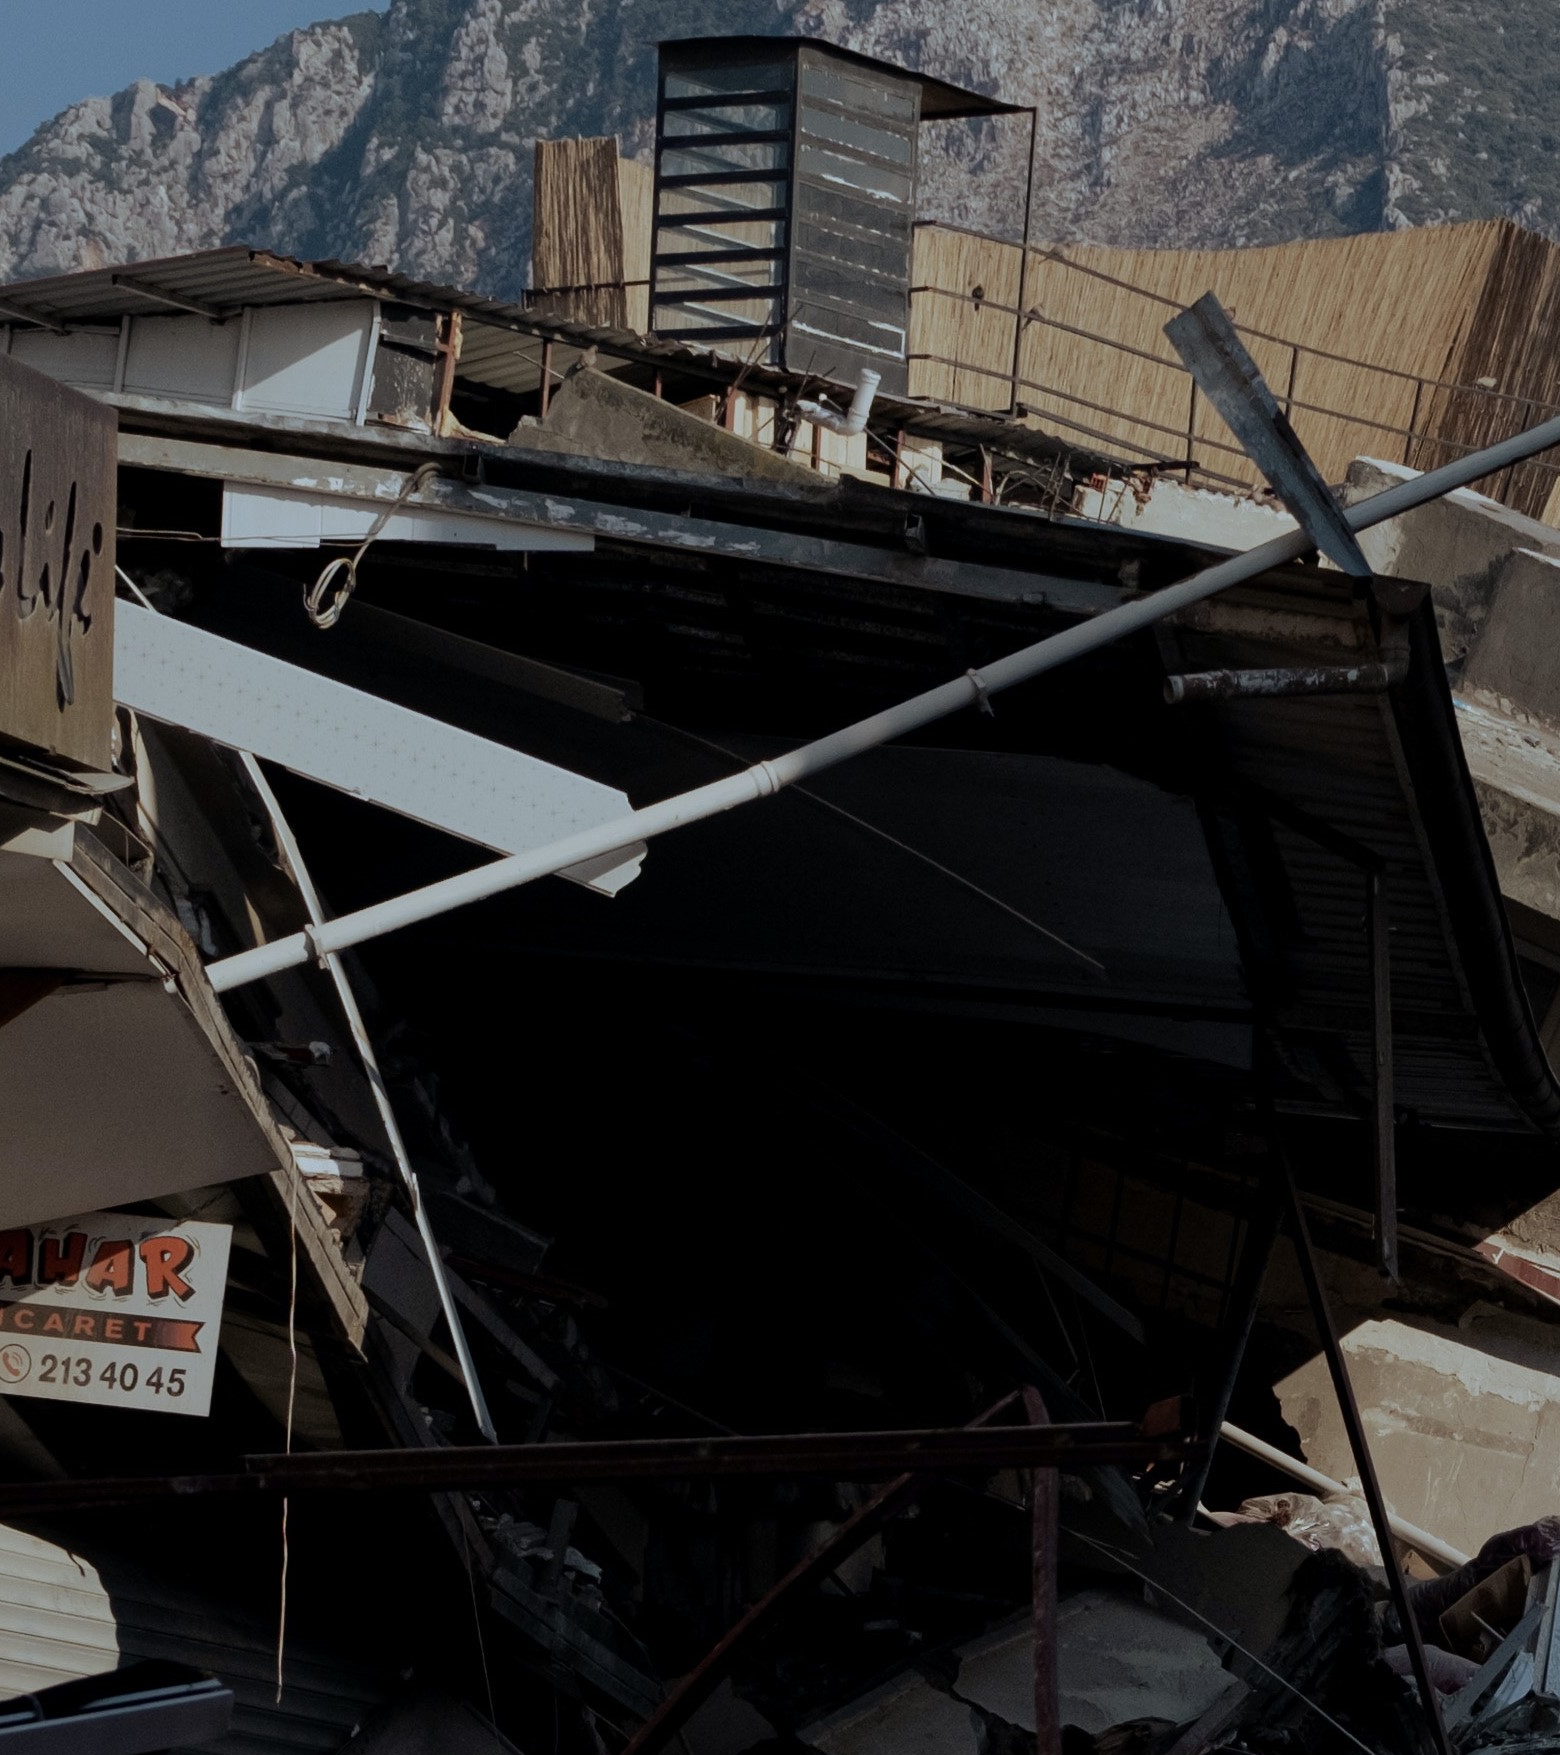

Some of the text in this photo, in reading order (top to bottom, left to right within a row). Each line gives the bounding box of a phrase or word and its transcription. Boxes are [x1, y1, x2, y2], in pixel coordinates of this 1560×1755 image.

[38, 1354, 187, 1397] 213 40 45
